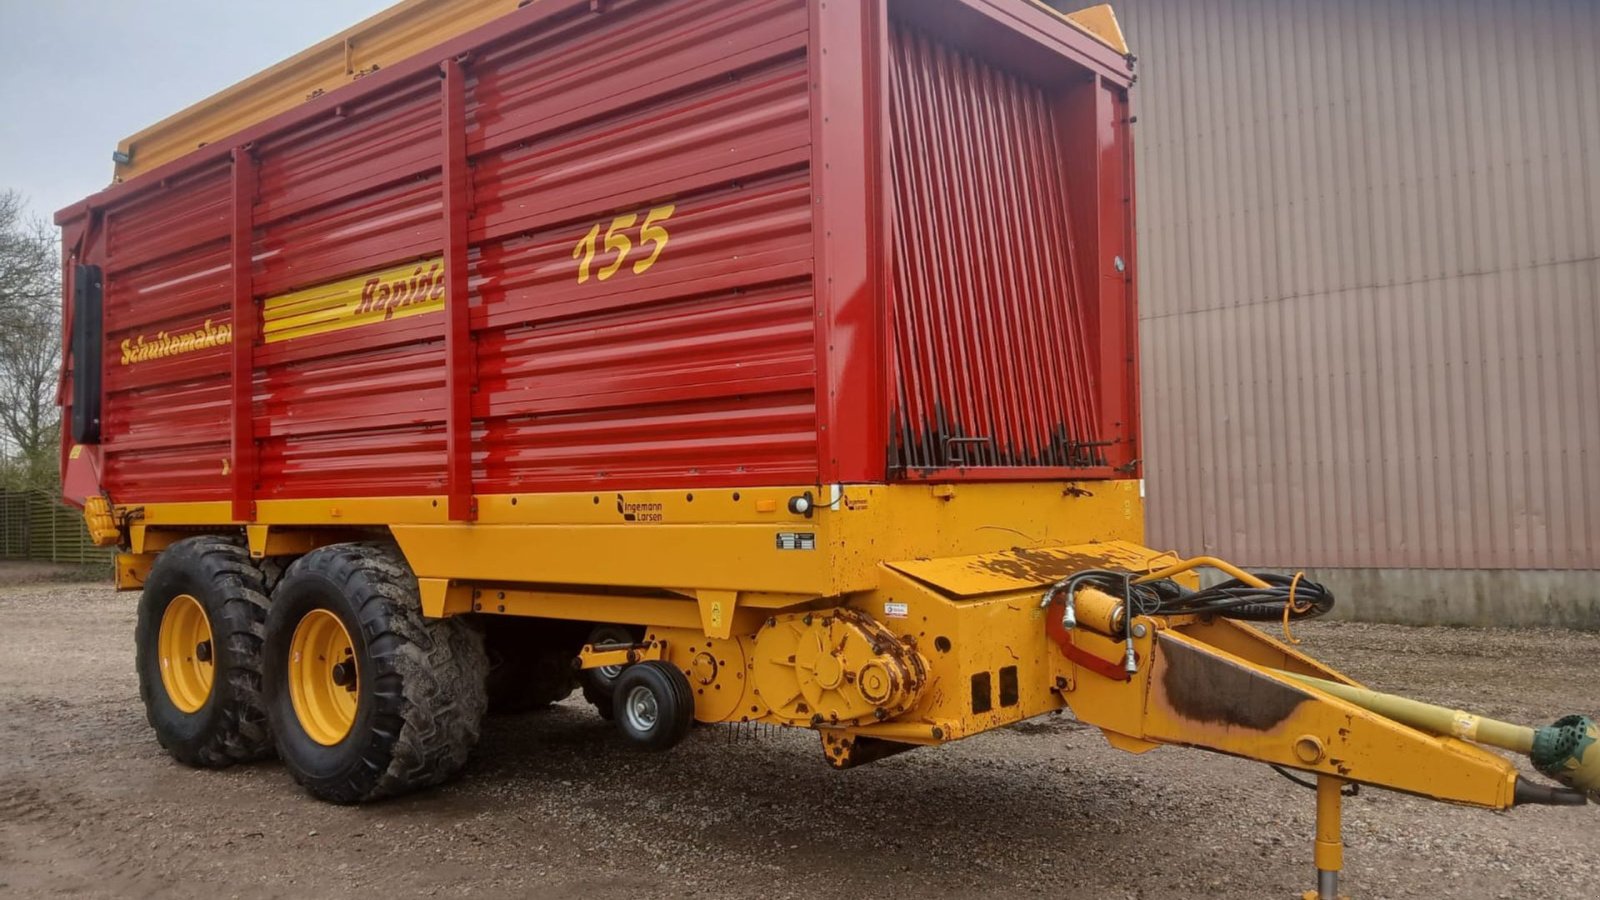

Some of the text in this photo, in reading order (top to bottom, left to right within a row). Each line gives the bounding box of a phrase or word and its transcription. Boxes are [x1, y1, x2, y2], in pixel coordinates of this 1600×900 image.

[572, 204, 676, 284] 155
[624, 502, 663, 513] Ingemann
[637, 512, 663, 521] Larsen
